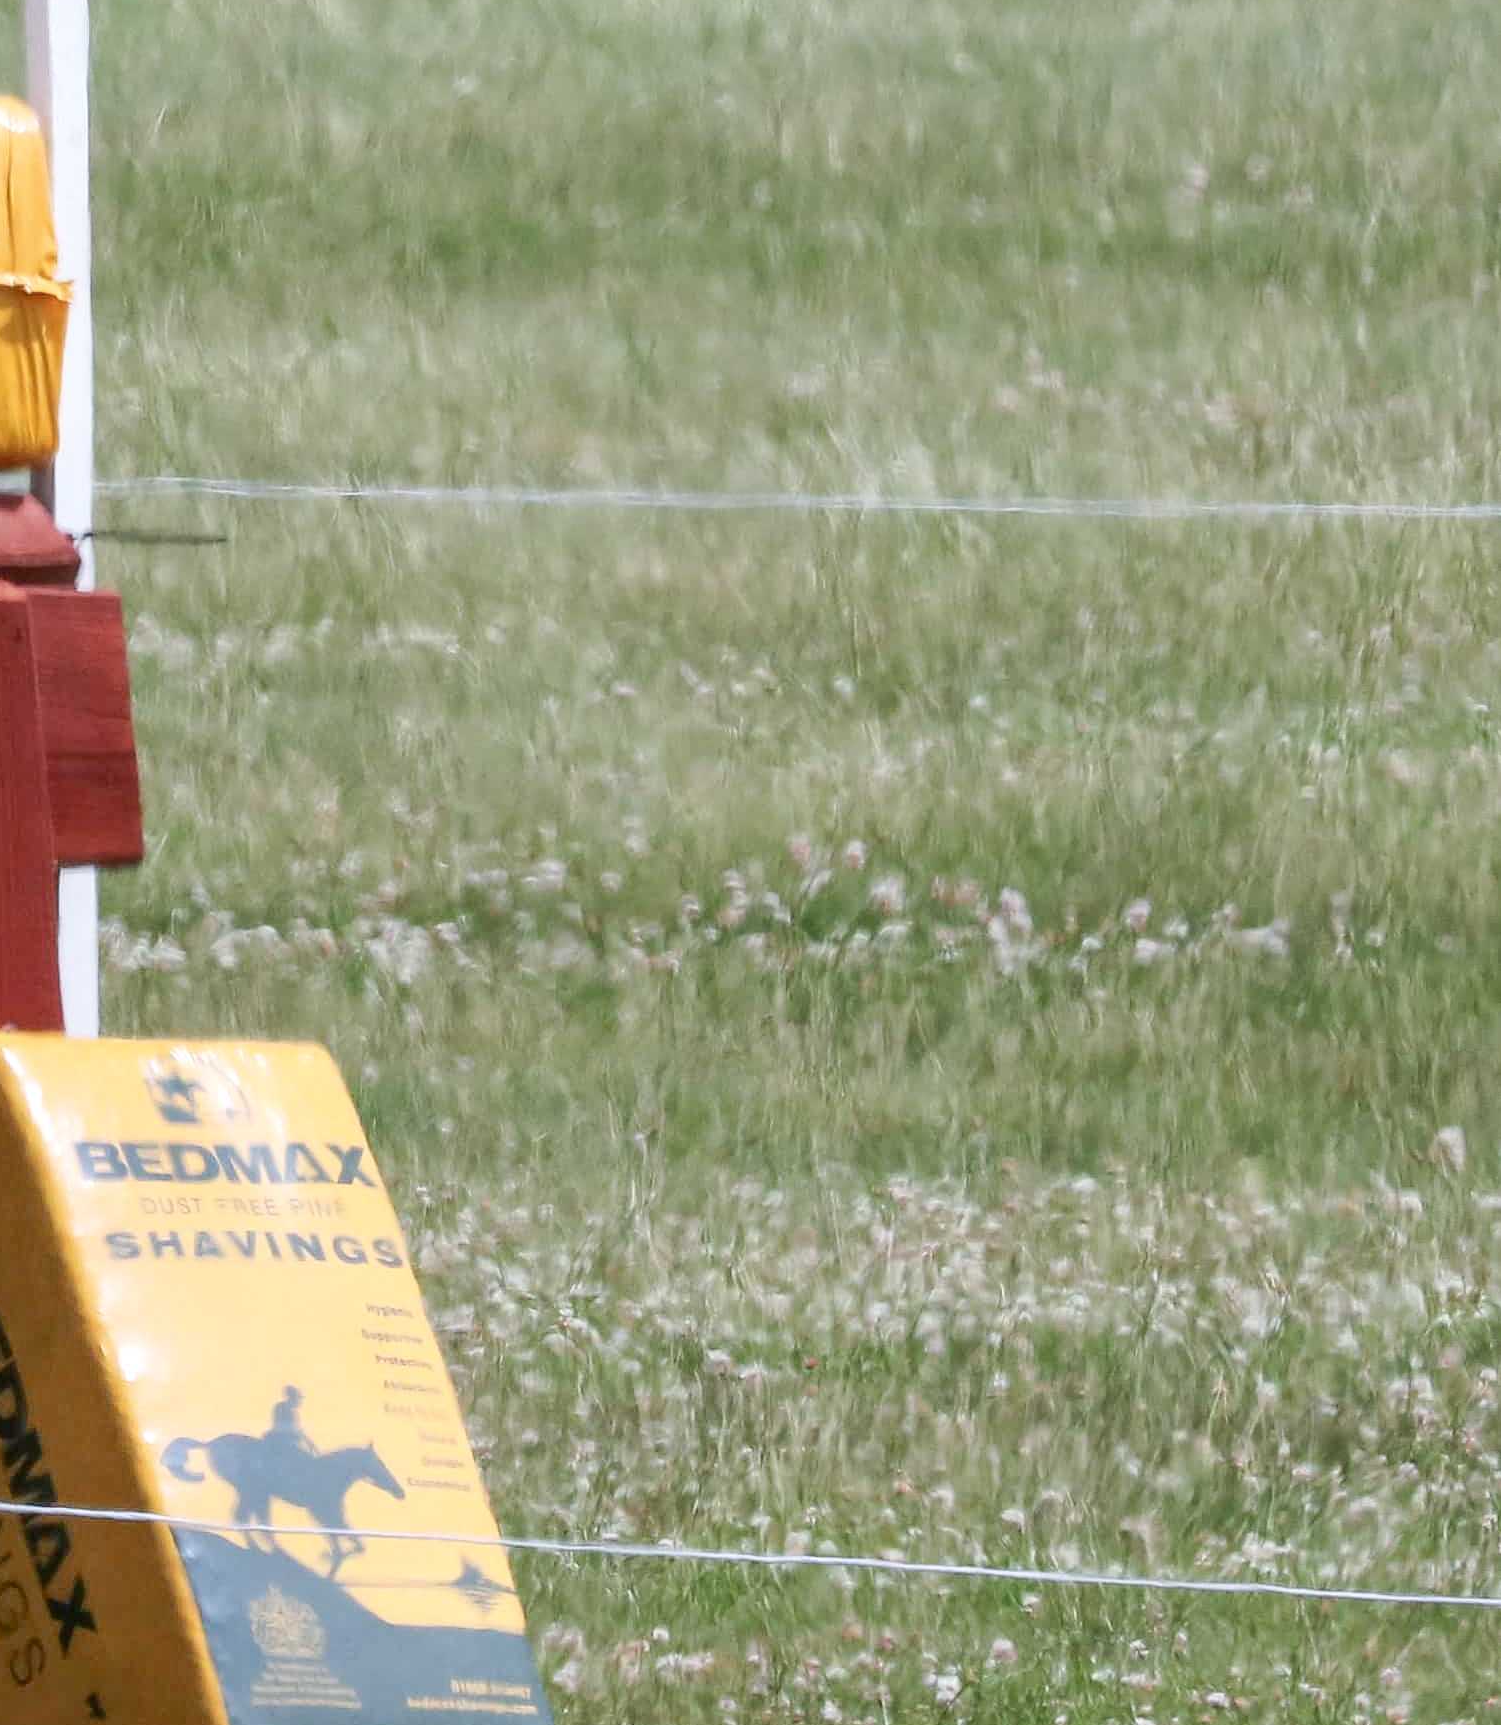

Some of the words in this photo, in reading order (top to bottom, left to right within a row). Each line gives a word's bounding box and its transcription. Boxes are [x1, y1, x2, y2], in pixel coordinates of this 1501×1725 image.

[74, 1142, 378, 1188] BEDMAX
[139, 1196, 202, 1216] DUST
[213, 1197, 281, 1217] FREE
[104, 1231, 403, 1268] SHAVINGS
